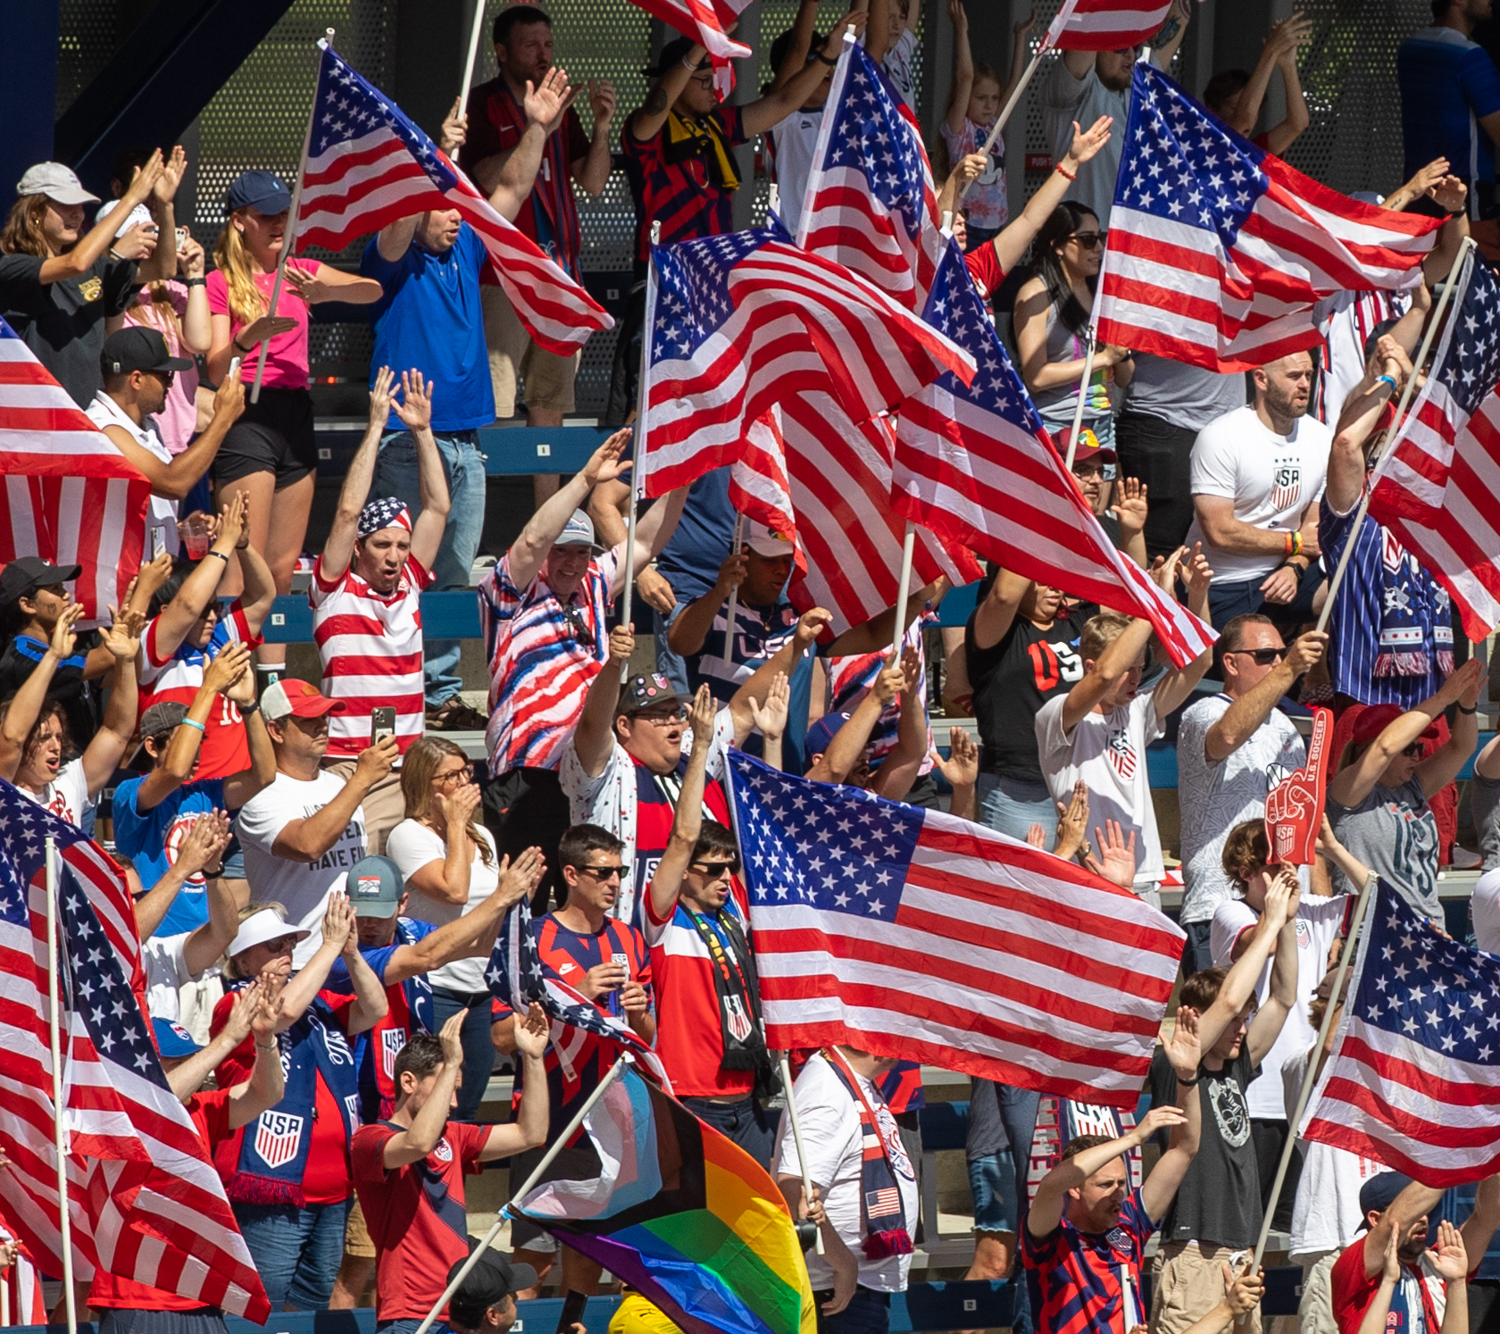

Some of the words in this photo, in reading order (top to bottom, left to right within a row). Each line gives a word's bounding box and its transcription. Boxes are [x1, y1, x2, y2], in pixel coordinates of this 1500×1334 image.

[1311, 720, 1325, 760] SOCCER
[383, 1028, 407, 1054] USA
[261, 1111, 301, 1135] USA
